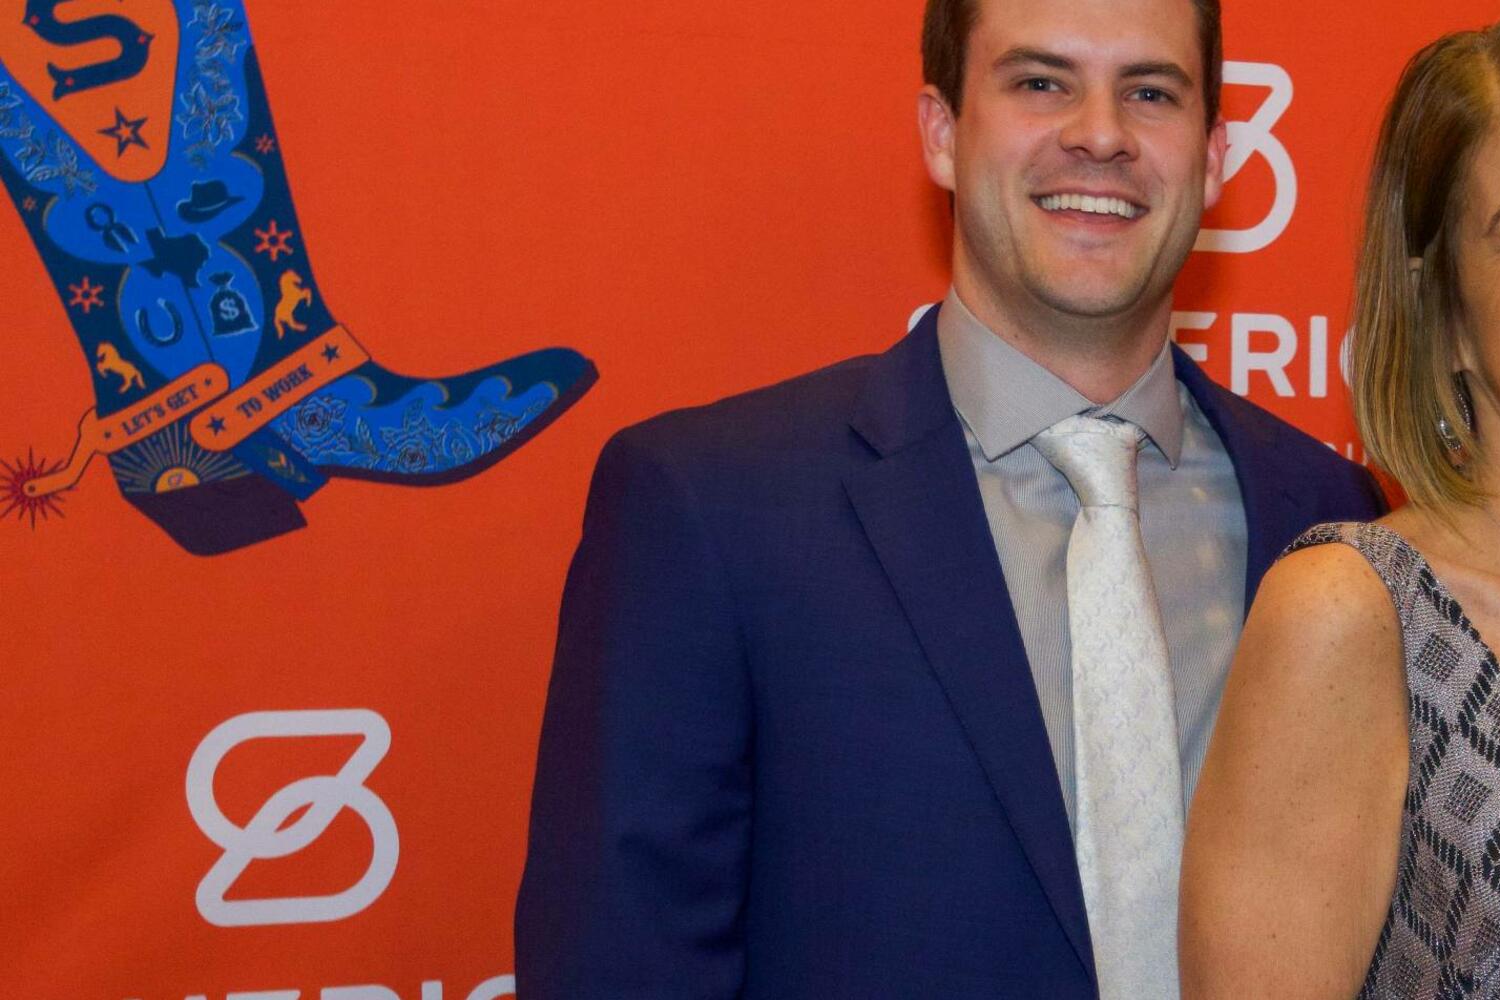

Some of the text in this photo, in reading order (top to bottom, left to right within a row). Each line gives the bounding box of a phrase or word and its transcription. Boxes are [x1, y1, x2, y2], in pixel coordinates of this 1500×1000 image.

[122, 384, 199, 436] LET'S GET
[236, 363, 314, 418] TO WORK
